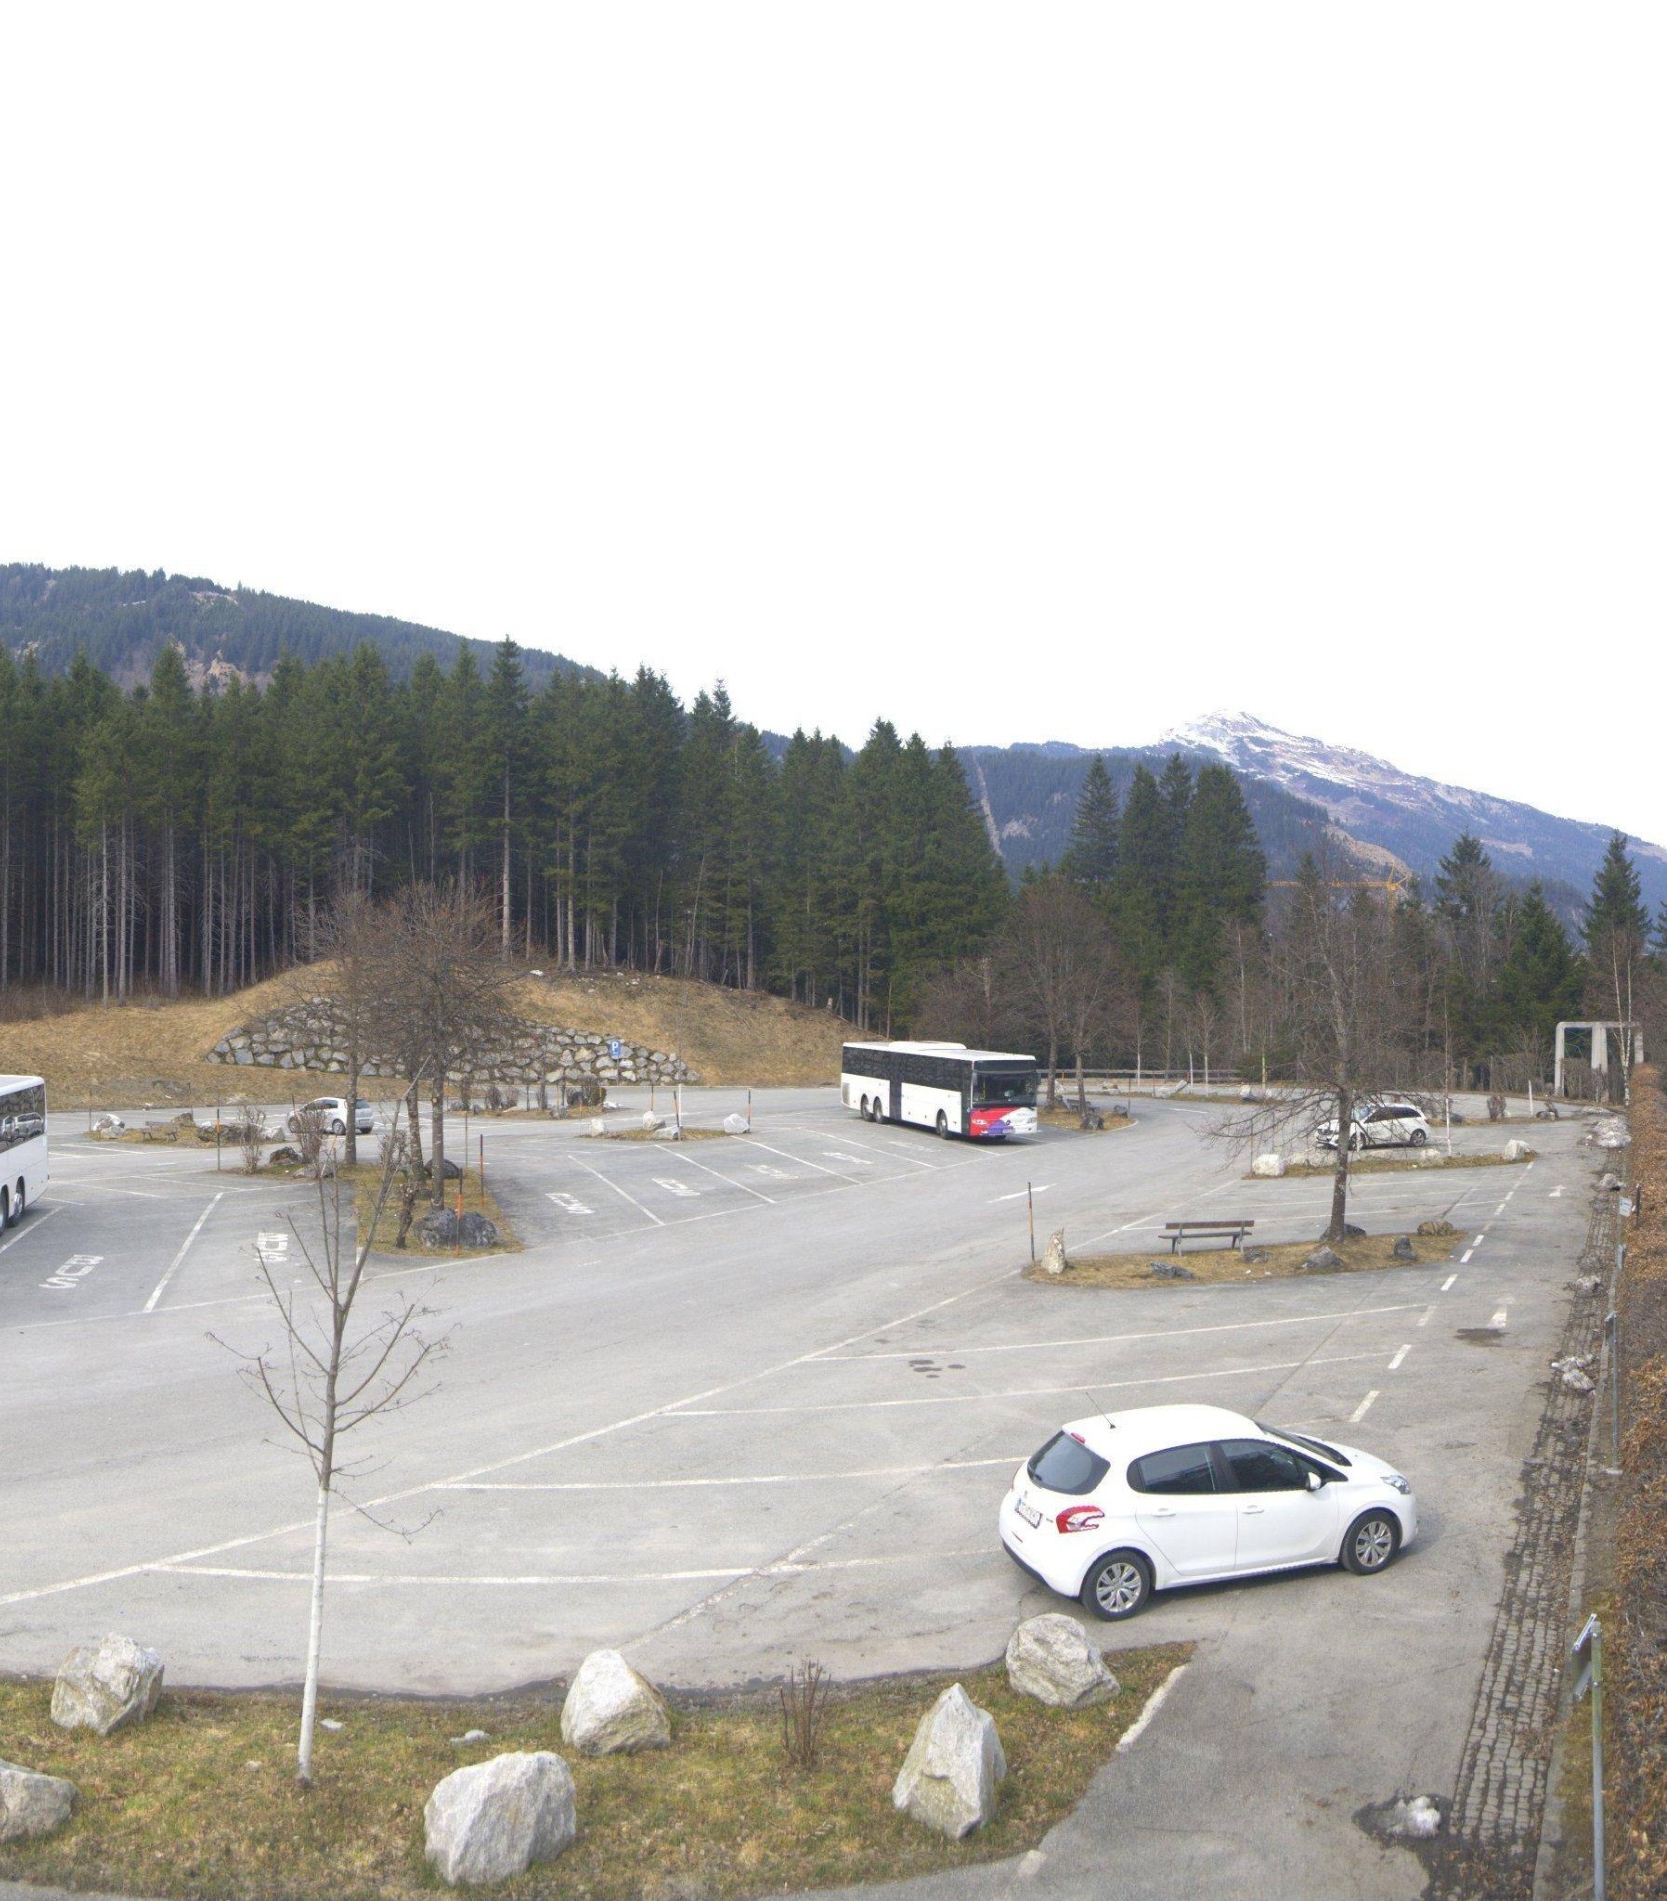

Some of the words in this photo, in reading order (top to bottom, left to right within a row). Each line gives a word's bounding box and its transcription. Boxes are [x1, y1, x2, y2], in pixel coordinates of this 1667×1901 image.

[611, 1041, 619, 1052] P
[254, 1232, 288, 1261] BUS
[38, 1254, 104, 1288] BUS
